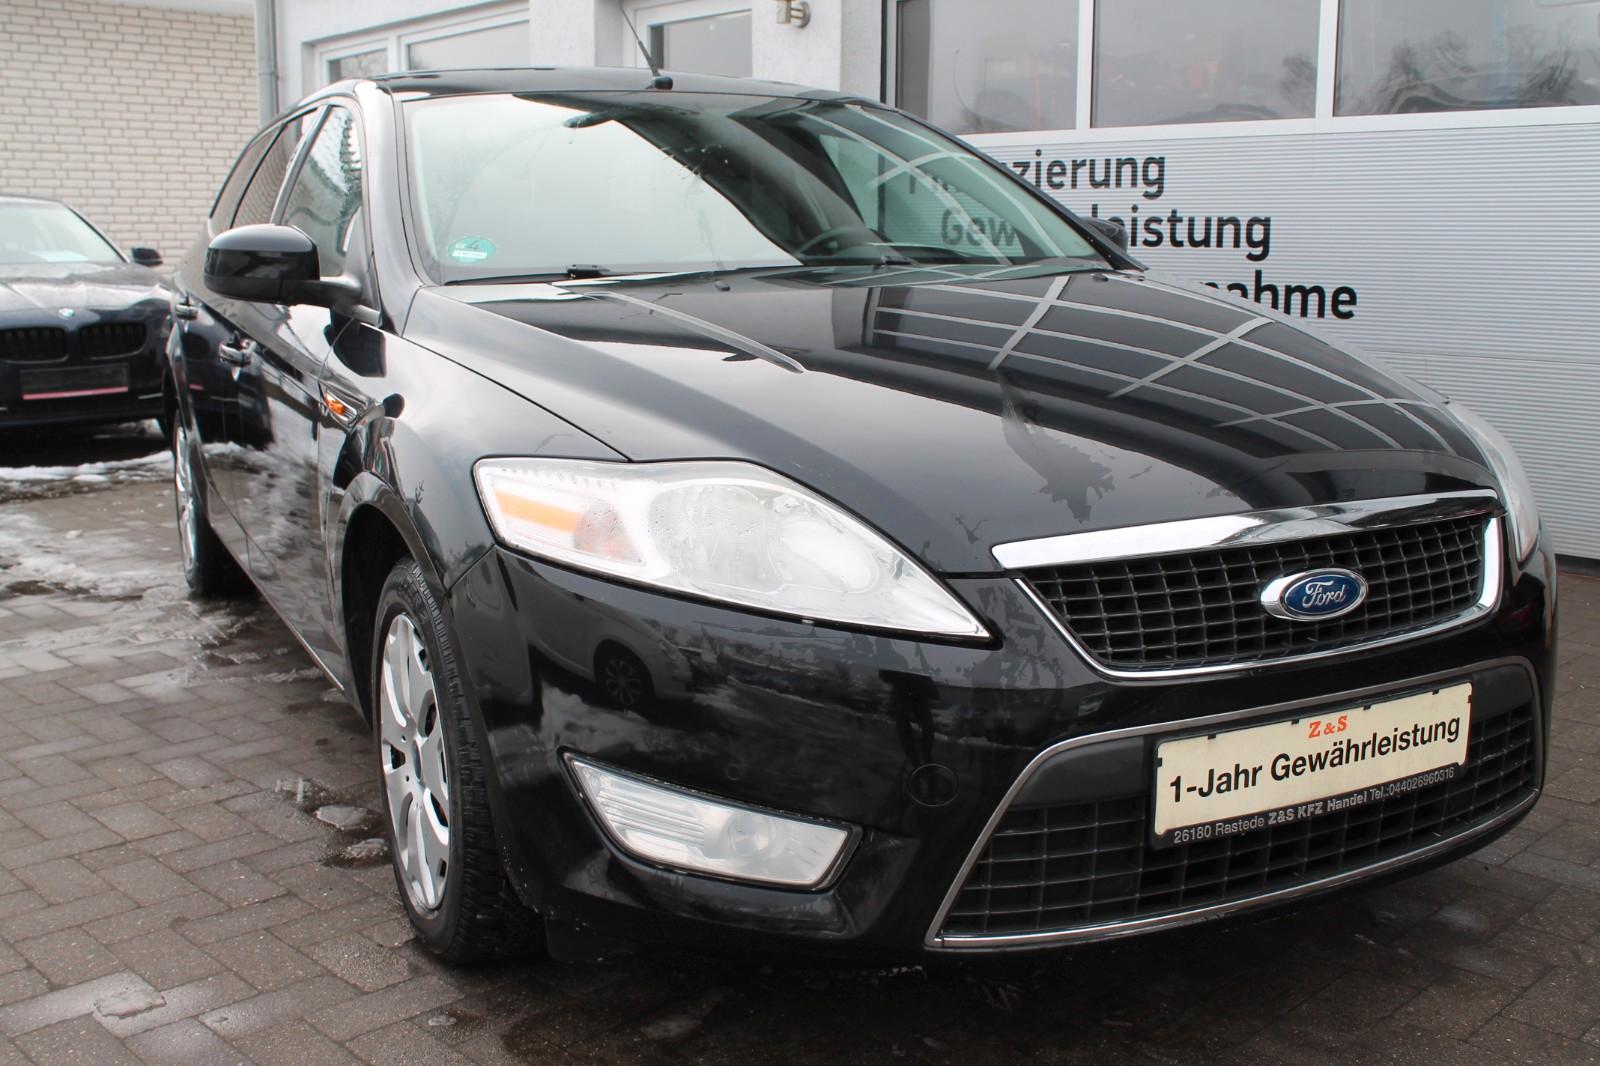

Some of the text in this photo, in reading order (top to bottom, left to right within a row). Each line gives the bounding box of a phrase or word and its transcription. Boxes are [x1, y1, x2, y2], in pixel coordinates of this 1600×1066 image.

[1302, 580, 1346, 608] Ford
[1308, 715, 1348, 738] Z&S
[1170, 717, 1460, 803] 1-Jahr Gewährleistung
[1173, 825, 1212, 844] 26180
[1215, 815, 1265, 836] Rastede
[1268, 808, 1295, 825] Z&S
[1297, 801, 1323, 817] KFZ
[1327, 791, 1368, 812] Handel
